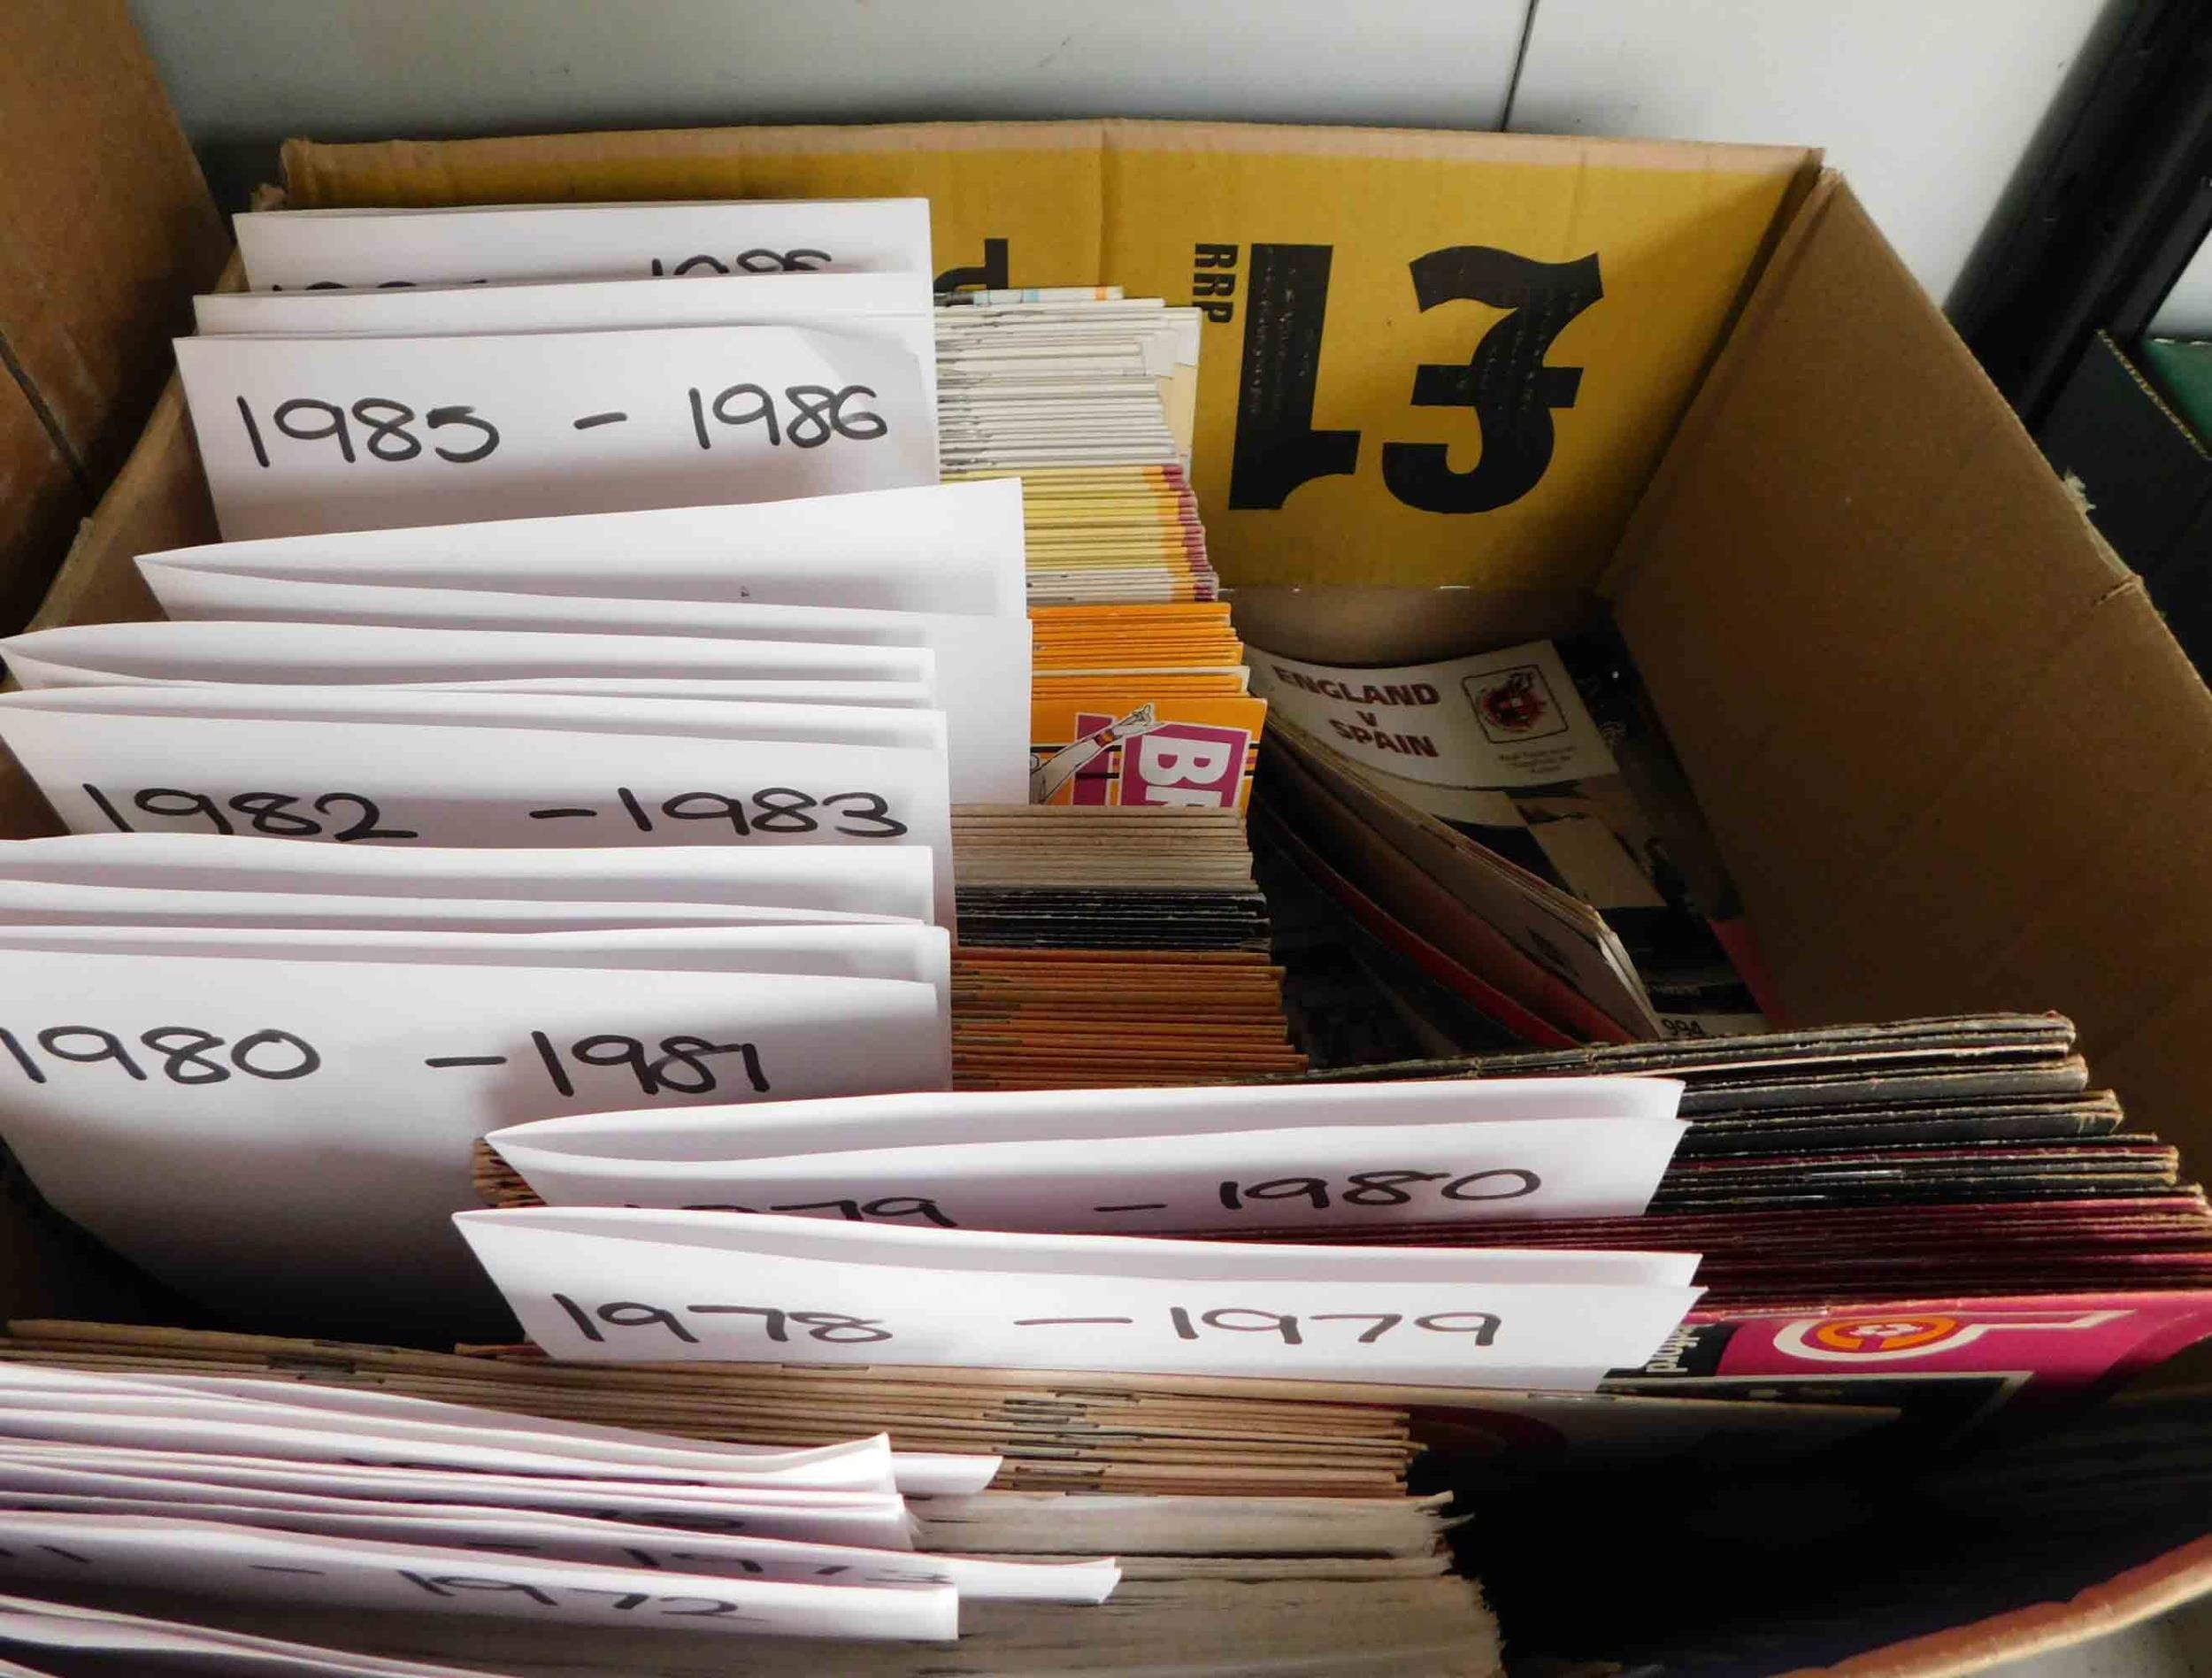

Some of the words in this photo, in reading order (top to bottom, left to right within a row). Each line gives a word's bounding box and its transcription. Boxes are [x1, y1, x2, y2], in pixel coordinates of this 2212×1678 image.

[1191, 243, 1239, 324] RRP
[236, 395, 500, 468] 1985
[688, 384, 888, 450] 1986
[1272, 665, 1440, 705] ENGLAND
[1329, 719, 1440, 758] SPAIN
[82, 782, 419, 842] 1982
[0, 1026, 321, 1085] 1980
[1219, 1167, 1541, 1211] 1980
[551, 1292, 893, 1344] 1978
[1170, 1305, 1503, 1347] 1979
